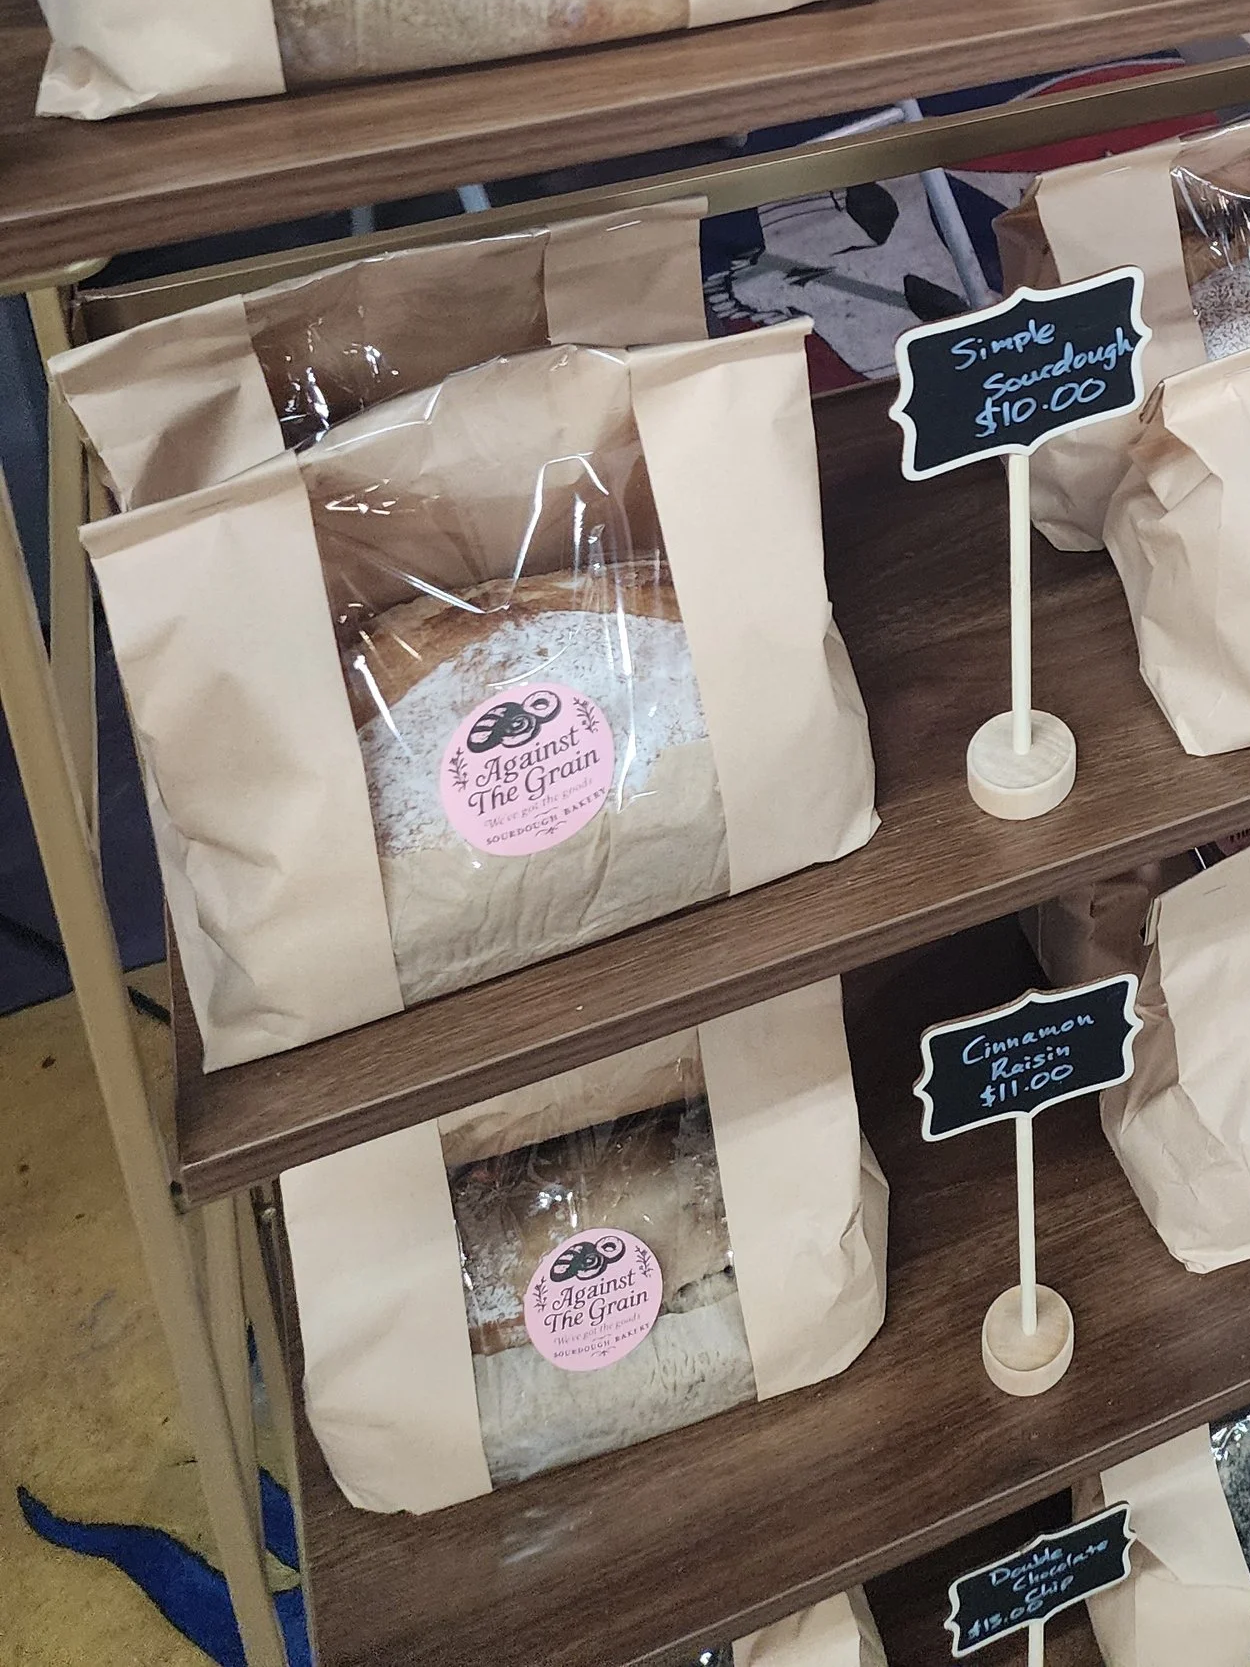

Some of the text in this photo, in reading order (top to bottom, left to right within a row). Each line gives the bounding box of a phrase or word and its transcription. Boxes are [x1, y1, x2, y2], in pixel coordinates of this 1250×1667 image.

[951, 319, 1056, 370] Simple
[983, 326, 1134, 400] Sourdough
[974, 378, 1107, 438] $10.00
[475, 726, 580, 787] Against
[468, 749, 600, 816] The Grain
[486, 786, 606, 845] SOURDOUGH BAKERY
[962, 1014, 1095, 1065] Cinnamon
[991, 1045, 1070, 1081] Raisin
[980, 1064, 1074, 1108] $11.00
[544, 1289, 649, 1333] The Grain
[552, 1268, 636, 1311] Against
[554, 1322, 650, 1358] SOURDOUGH BAKERY
[989, 1547, 1063, 1586] Double
[1013, 1539, 1109, 1592] Chocolate
